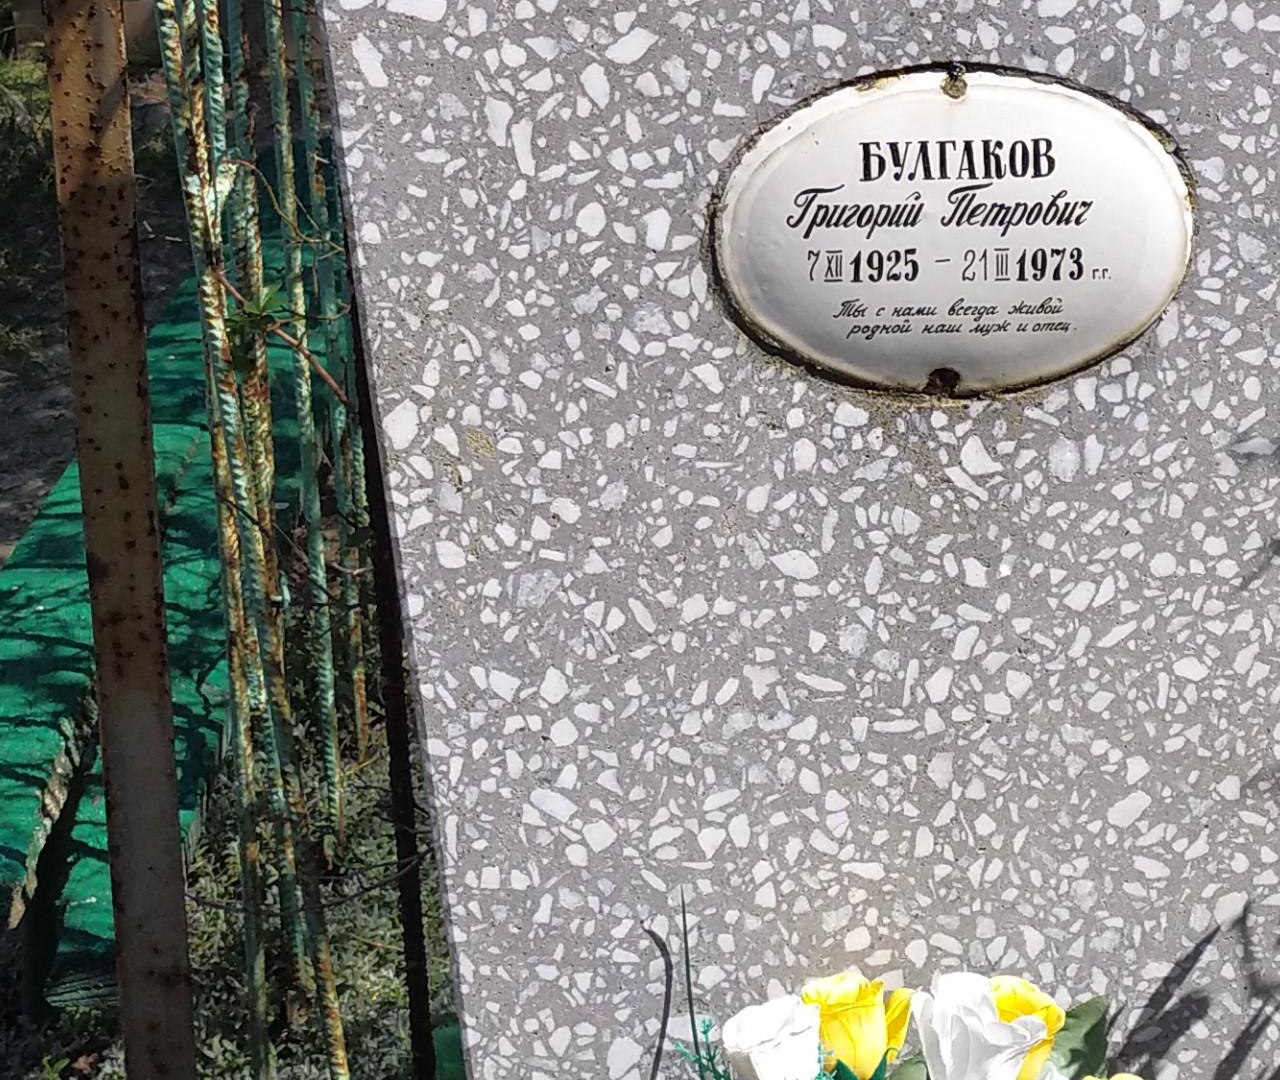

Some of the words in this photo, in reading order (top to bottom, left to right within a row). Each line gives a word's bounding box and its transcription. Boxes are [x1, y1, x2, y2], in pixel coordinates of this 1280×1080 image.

[859, 137, 1056, 182] БУЛГАКОВ
[786, 184, 925, 239] Григорий
[940, 182, 1094, 238] Петрович
[833, 298, 868, 318] Ты
[875, 307, 885, 317] с
[891, 305, 937, 317] нами
[947, 297, 999, 321] всегда
[1007, 296, 1064, 316] живой
[846, 319, 912, 340] родной
[921, 322, 963, 334] наш
[968, 319, 1012, 337] муж
[1016, 322, 1029, 333] и
